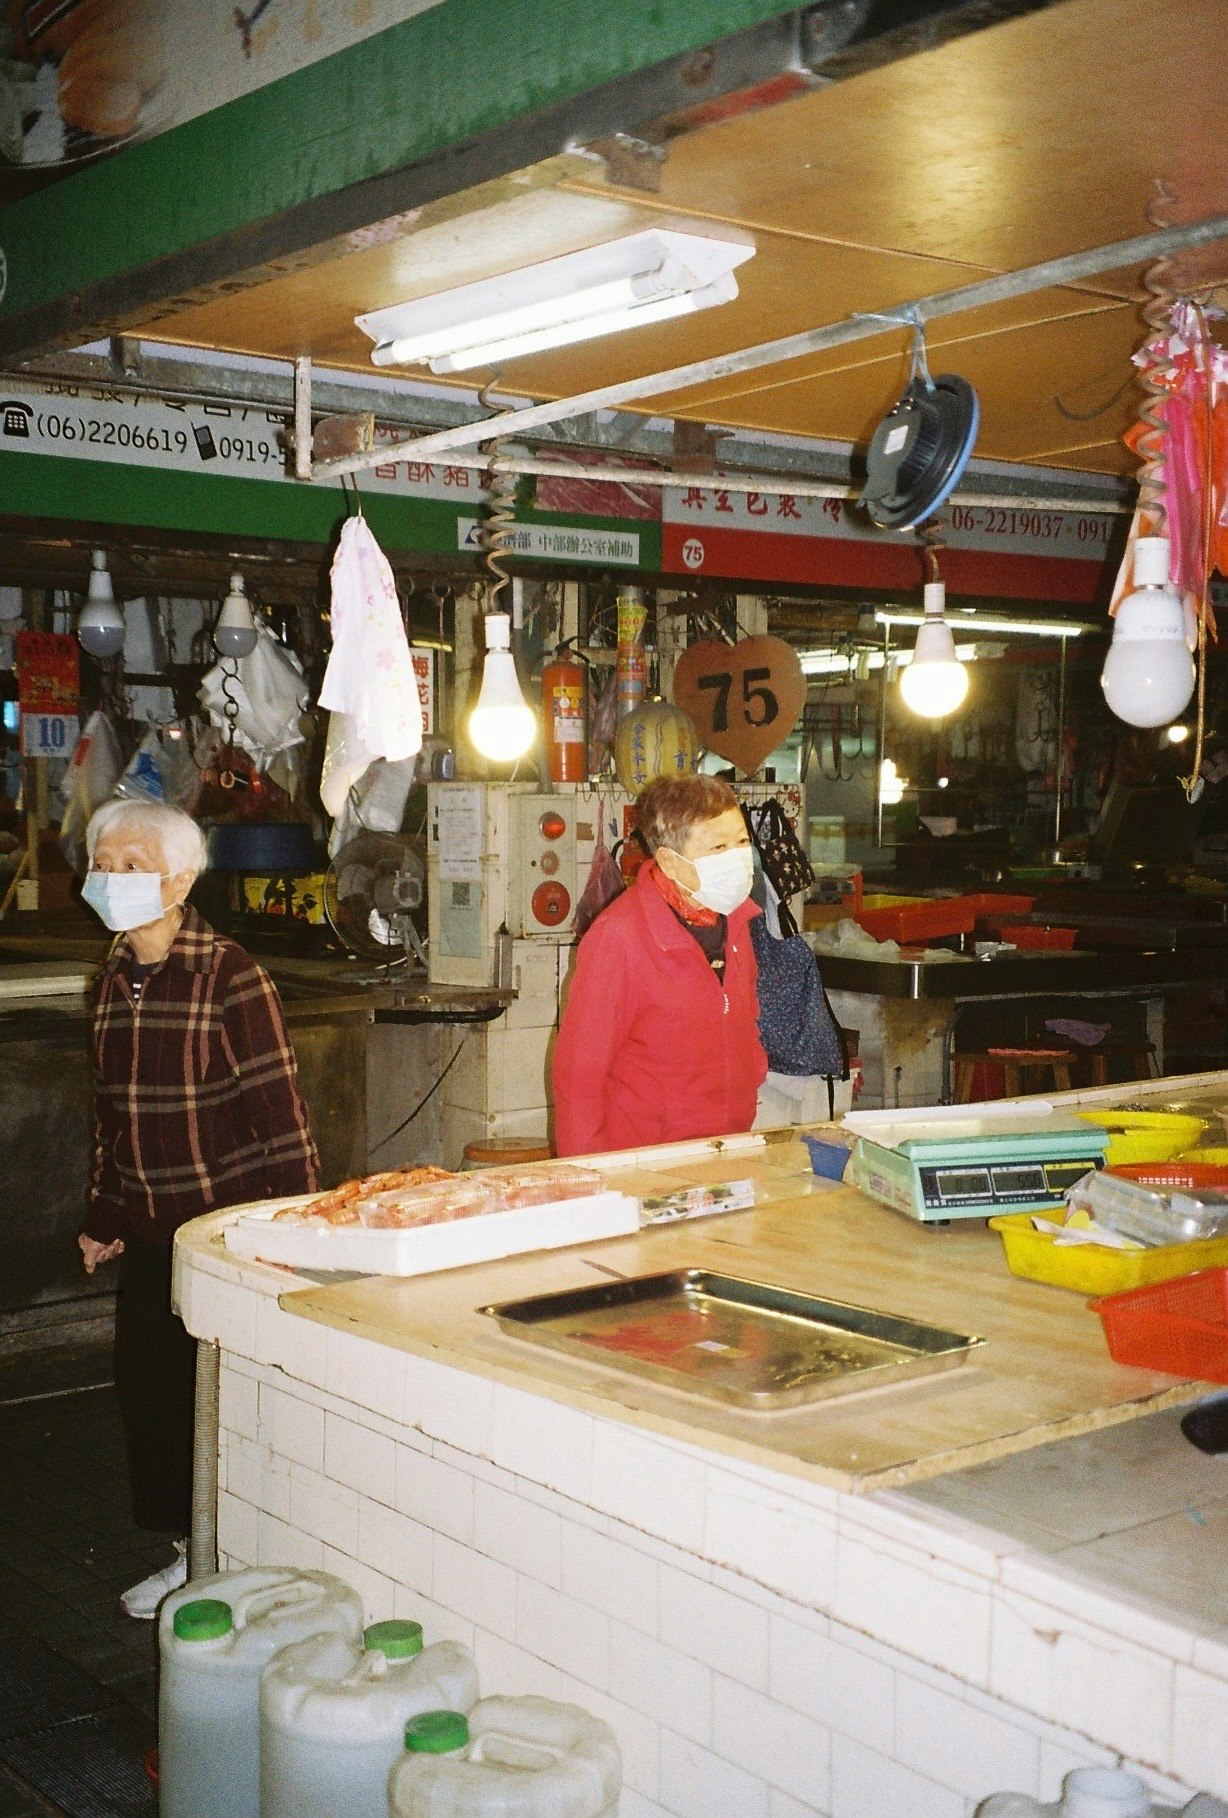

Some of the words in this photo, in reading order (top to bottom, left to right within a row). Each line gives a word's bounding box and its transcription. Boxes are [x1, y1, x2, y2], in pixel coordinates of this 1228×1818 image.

[37, 413, 188, 454] (06)2206619
[684, 544, 704, 562] 75
[697, 667, 780, 733] 75
[39, 717, 66, 748] 10
